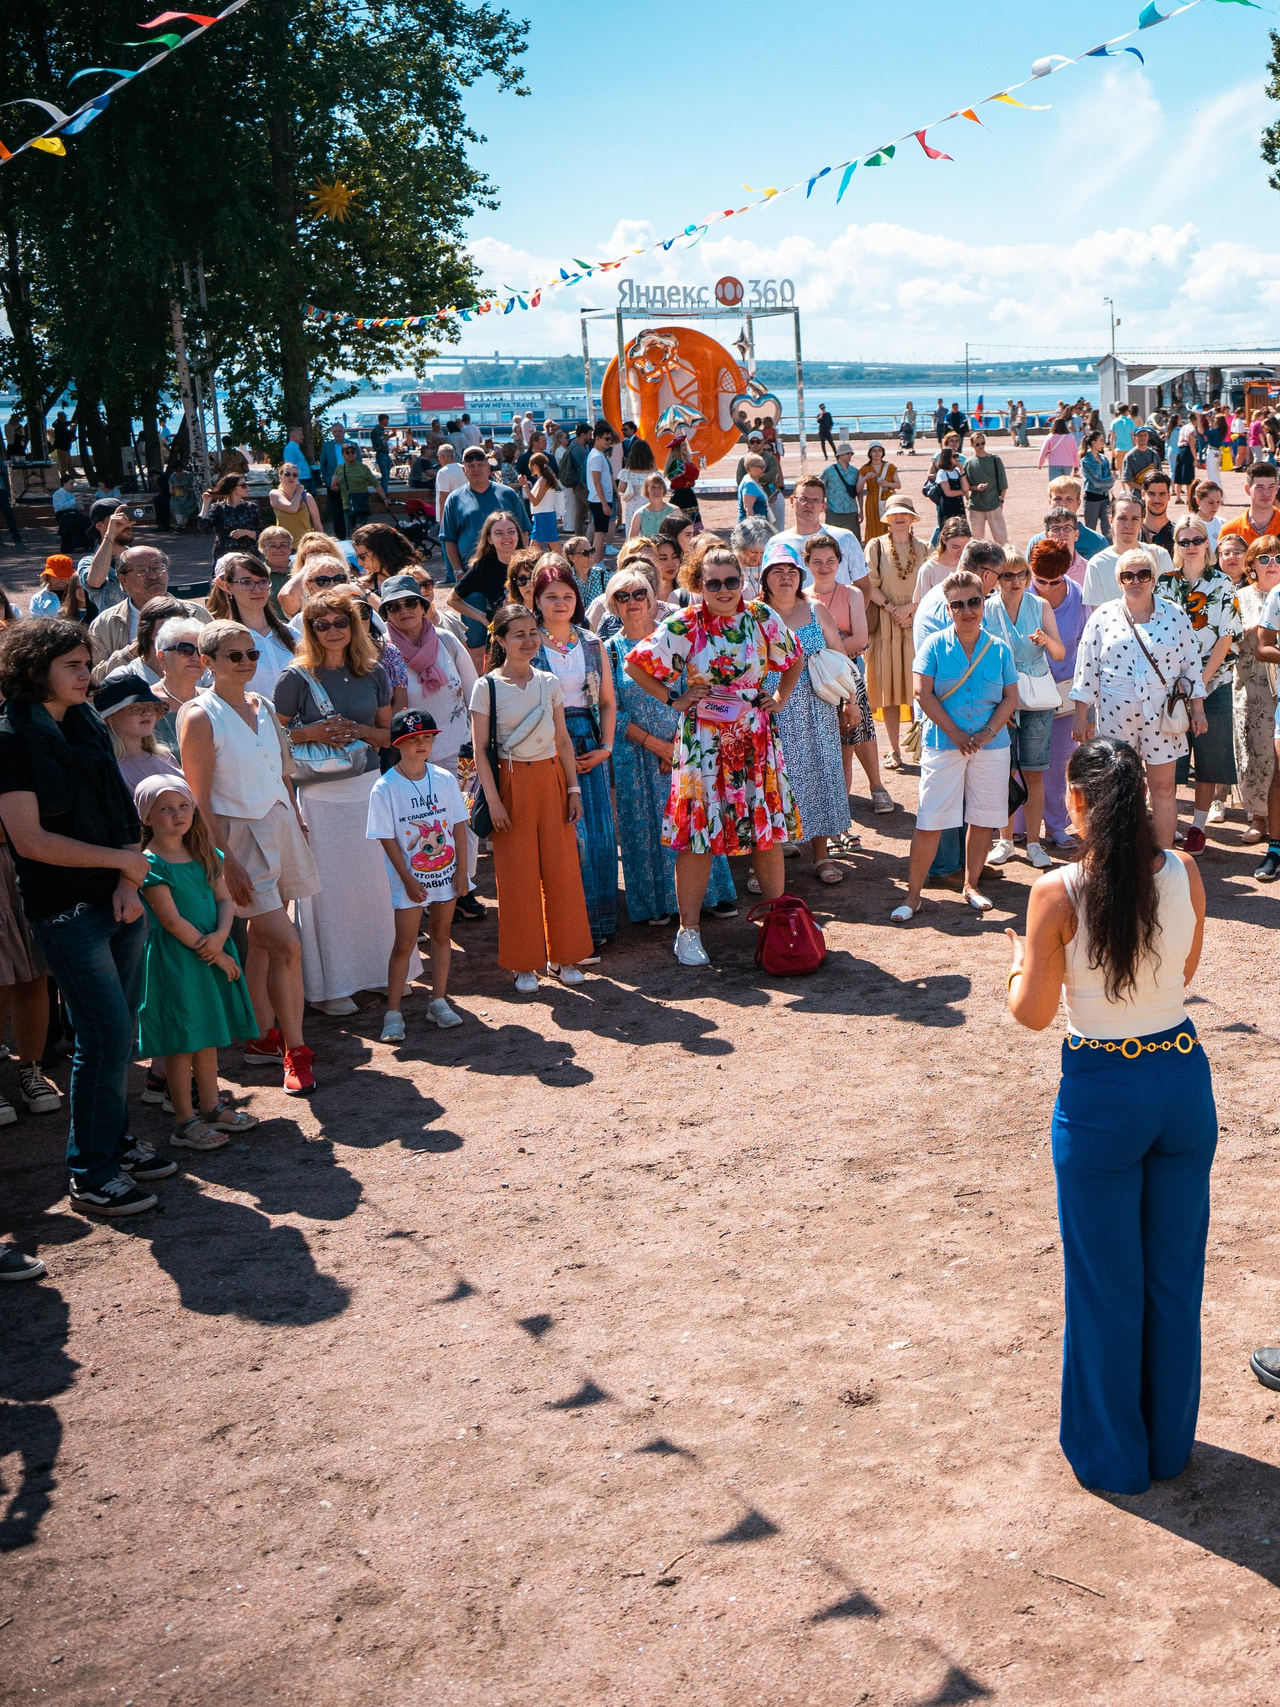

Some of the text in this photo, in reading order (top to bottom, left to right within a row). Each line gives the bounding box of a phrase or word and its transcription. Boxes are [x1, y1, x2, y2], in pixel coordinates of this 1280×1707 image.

[617, 278, 795, 308] Яндекс 360
[705, 702, 730, 713] ZUMBA
[411, 793, 439, 809] ЛАДА
[407, 810, 435, 821] СЛАДКИЙ
[414, 871, 442, 880] ЧТОБЫ
